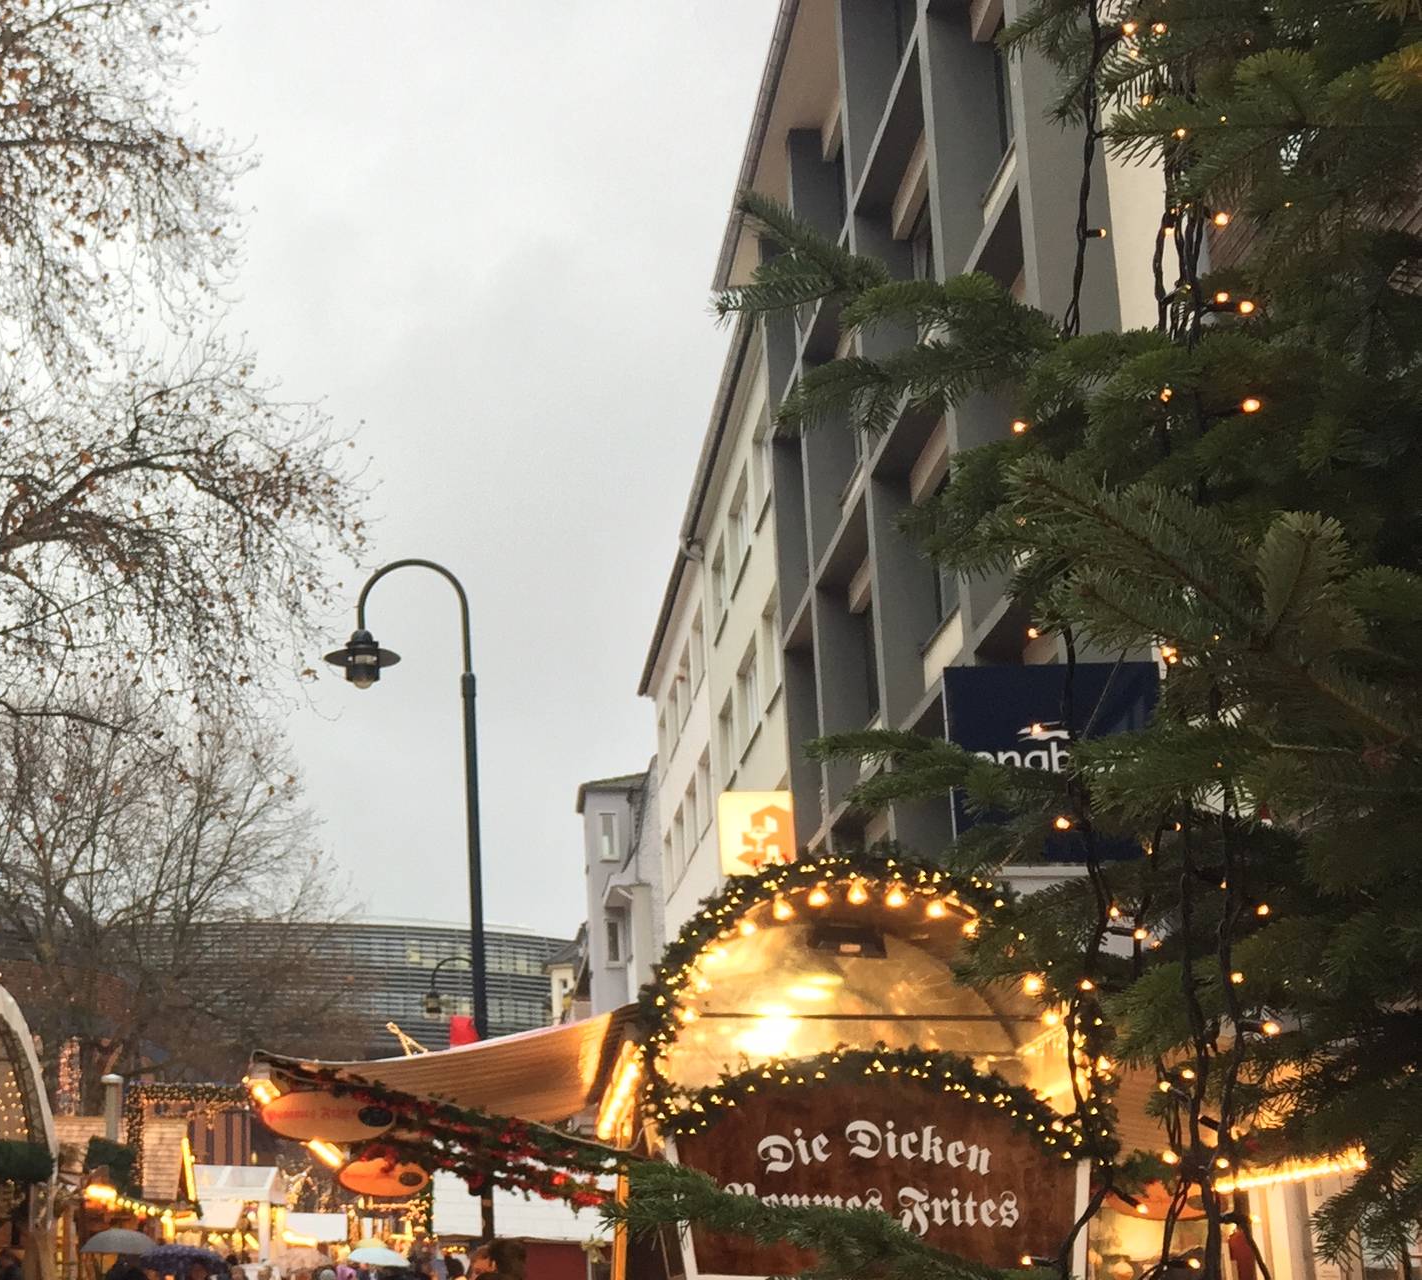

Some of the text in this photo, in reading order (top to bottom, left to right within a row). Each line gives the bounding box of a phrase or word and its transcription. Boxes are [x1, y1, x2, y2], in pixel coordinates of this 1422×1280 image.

[757, 1120, 993, 1175] Die Dicken
[897, 1186, 1019, 1237] Frites
